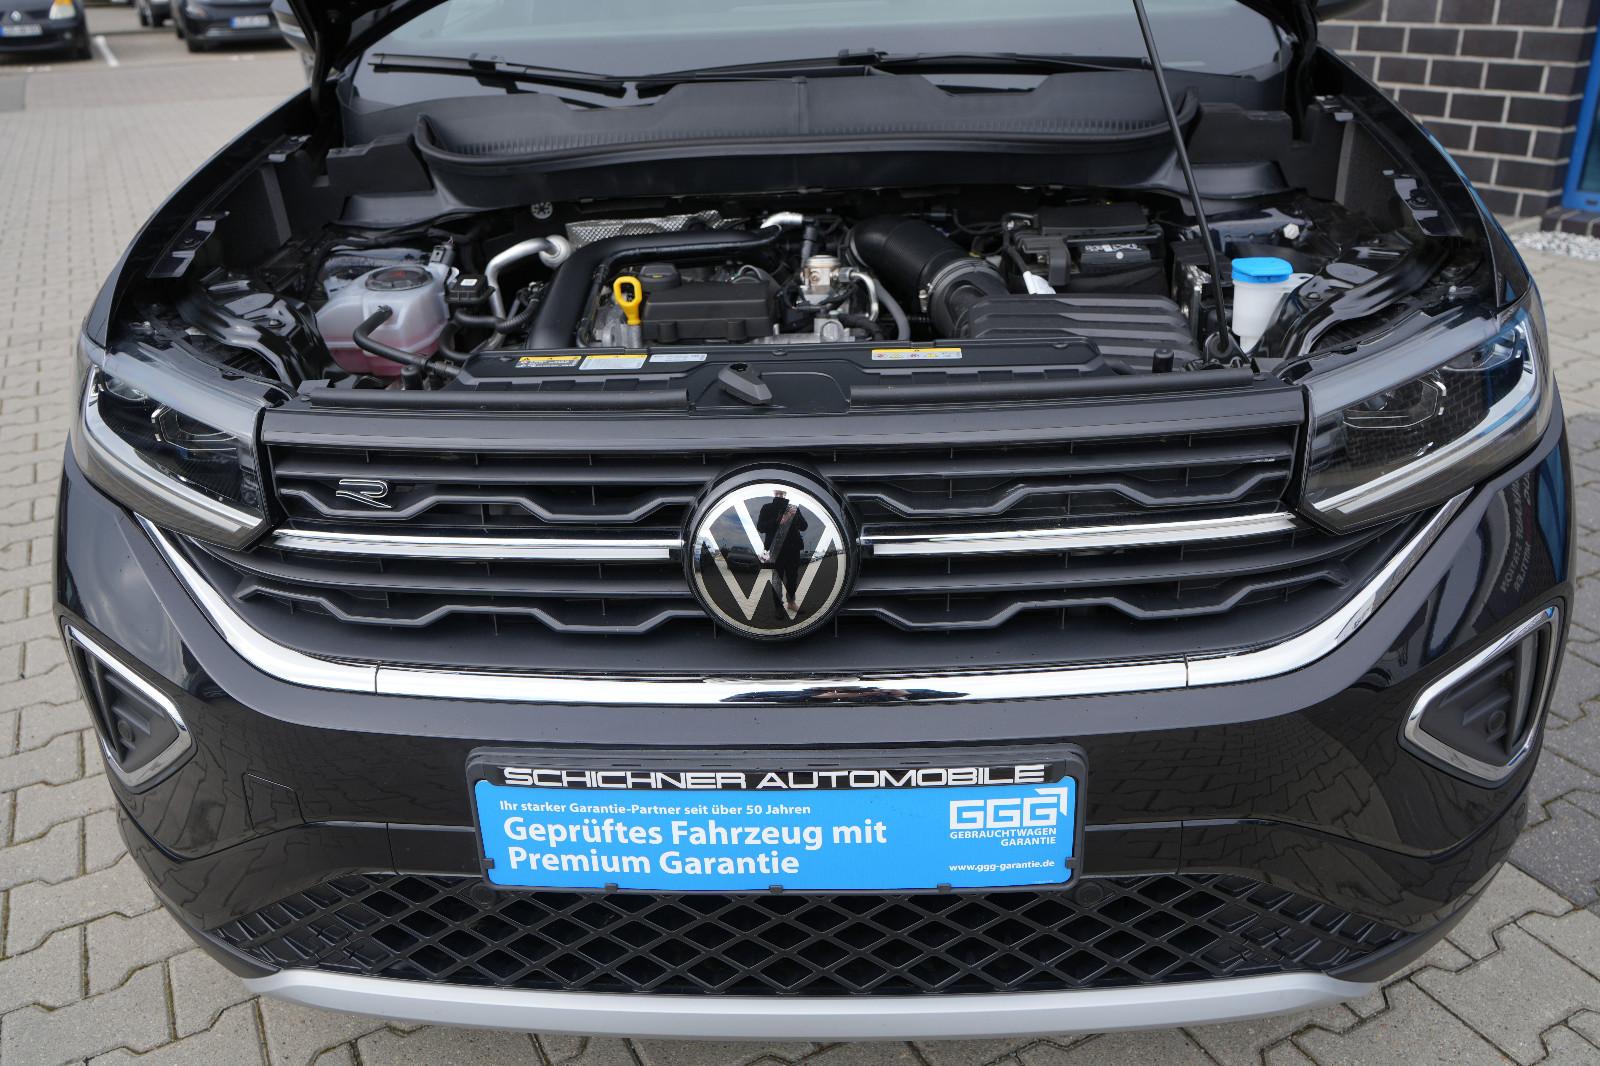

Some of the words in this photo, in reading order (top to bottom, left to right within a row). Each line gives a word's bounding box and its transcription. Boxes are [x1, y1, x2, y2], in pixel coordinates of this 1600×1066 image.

[503, 767, 747, 789] SCHICHNER
[755, 764, 1045, 789] AUTOMOBILE
[500, 800, 518, 811] Ihr
[521, 801, 567, 813] starker
[569, 803, 681, 815] Garantie-Partner
[684, 804, 709, 815] seit
[711, 804, 743, 815] über
[746, 804, 763, 815] 50
[765, 804, 811, 815] Jahren
[949, 796, 1058, 830] GGG
[503, 816, 663, 848] Geprüftes
[671, 819, 823, 851] Fahrzeug
[832, 818, 888, 844] mit
[949, 827, 1057, 839] GEBRAUCHTWAGEN
[1000, 836, 1057, 847] GARANTIE
[508, 846, 651, 874] Premium
[659, 850, 800, 875] Garantie
[949, 859, 1055, 873] www.ggg-garantie.de
